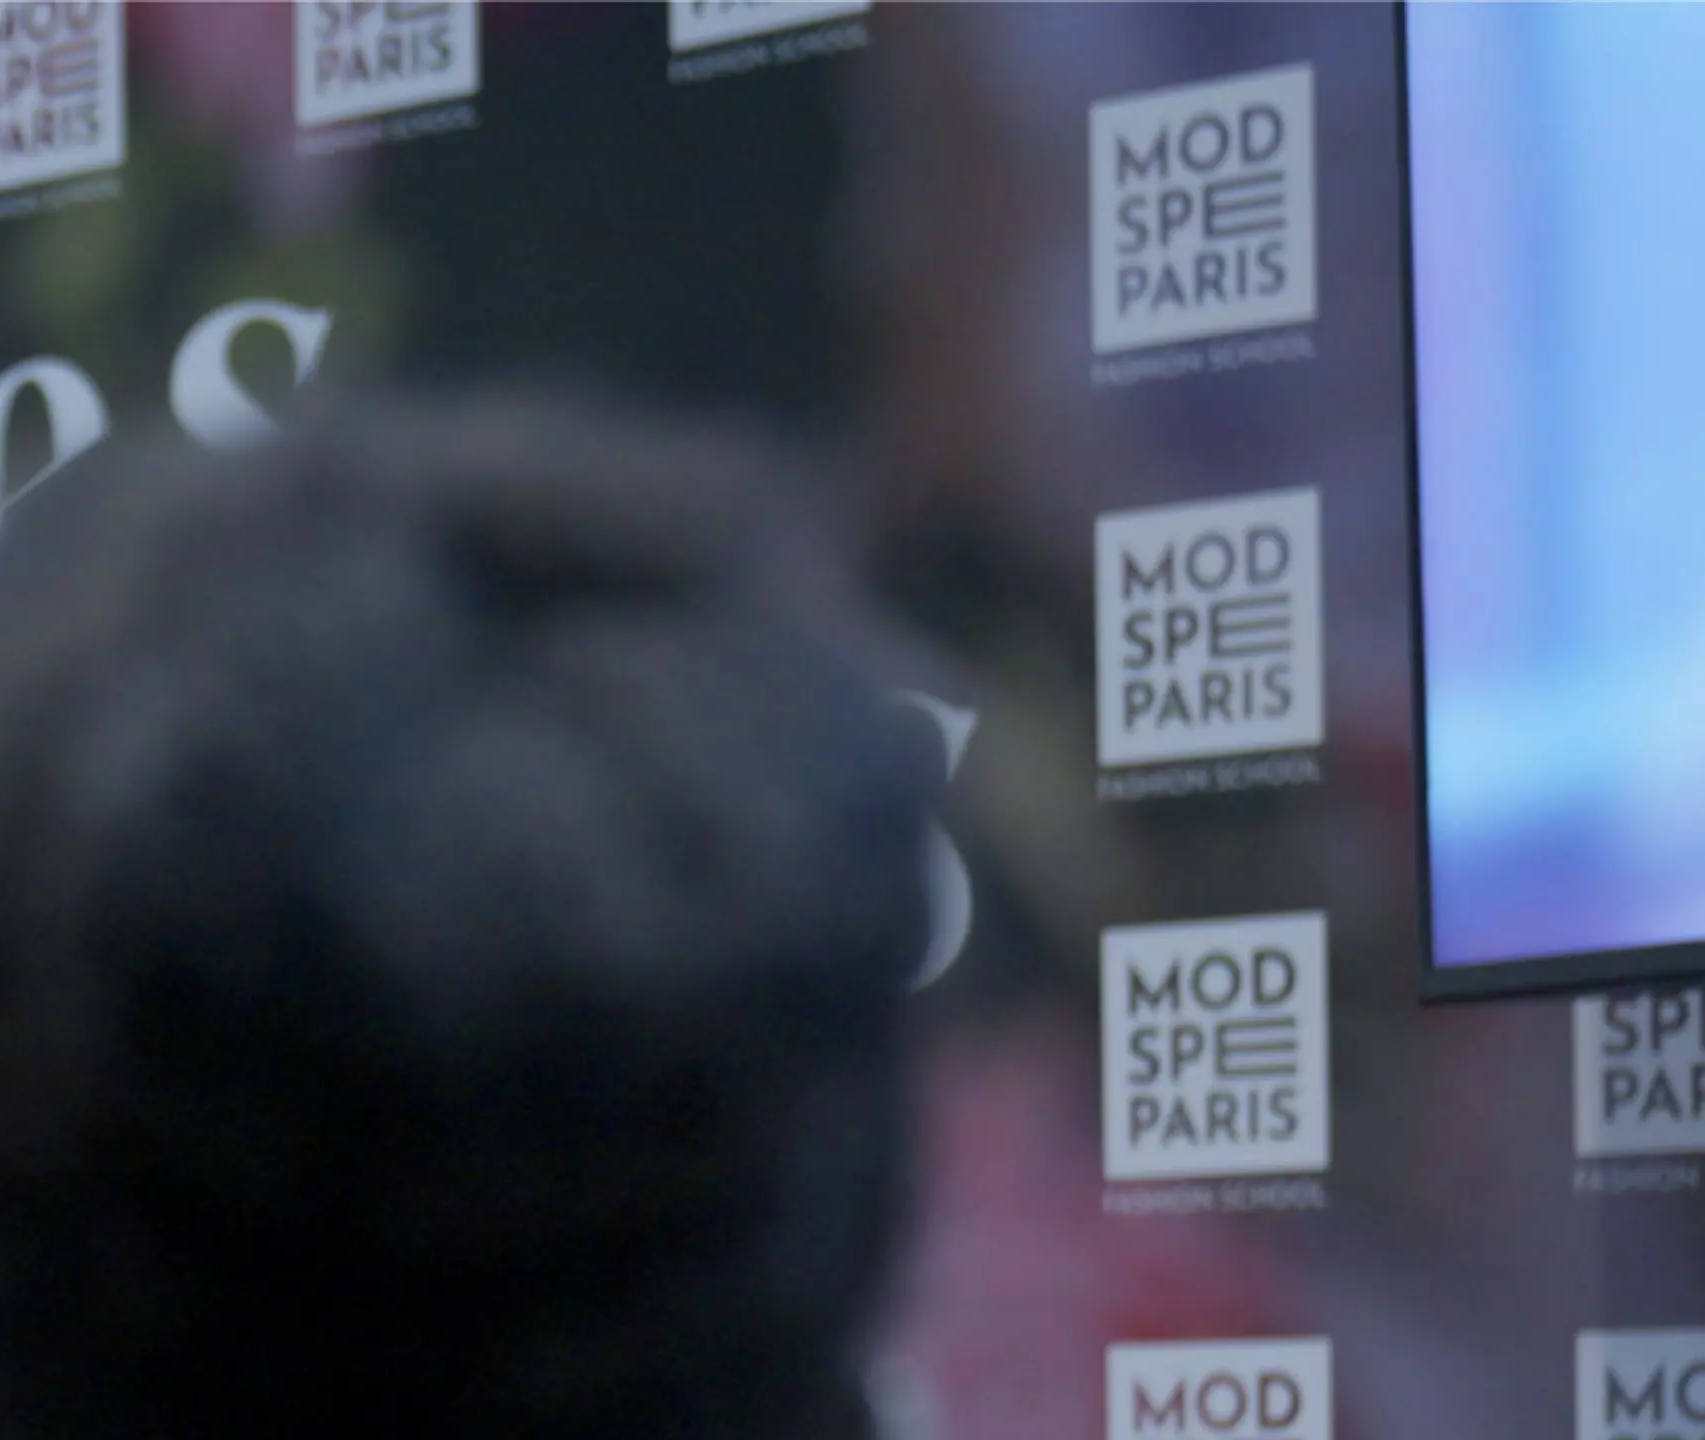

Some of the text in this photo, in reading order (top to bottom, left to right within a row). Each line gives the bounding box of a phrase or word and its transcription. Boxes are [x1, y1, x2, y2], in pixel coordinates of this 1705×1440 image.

[316, 22, 452, 94] PARIS
[1114, 104, 1285, 187] MOD
[1116, 170, 1285, 255] SPE
[1117, 241, 1286, 318] PARIS
[1122, 525, 1291, 599] MOD
[1122, 595, 1291, 669] SPE
[1123, 663, 1291, 734] PARIS
[1127, 948, 1297, 1016] MOD
[1129, 1016, 1296, 1085] SPE
[1603, 994, 1705, 1055] SP
[1129, 1086, 1298, 1149] PARIS
[1132, 1371, 1301, 1432] MOD
